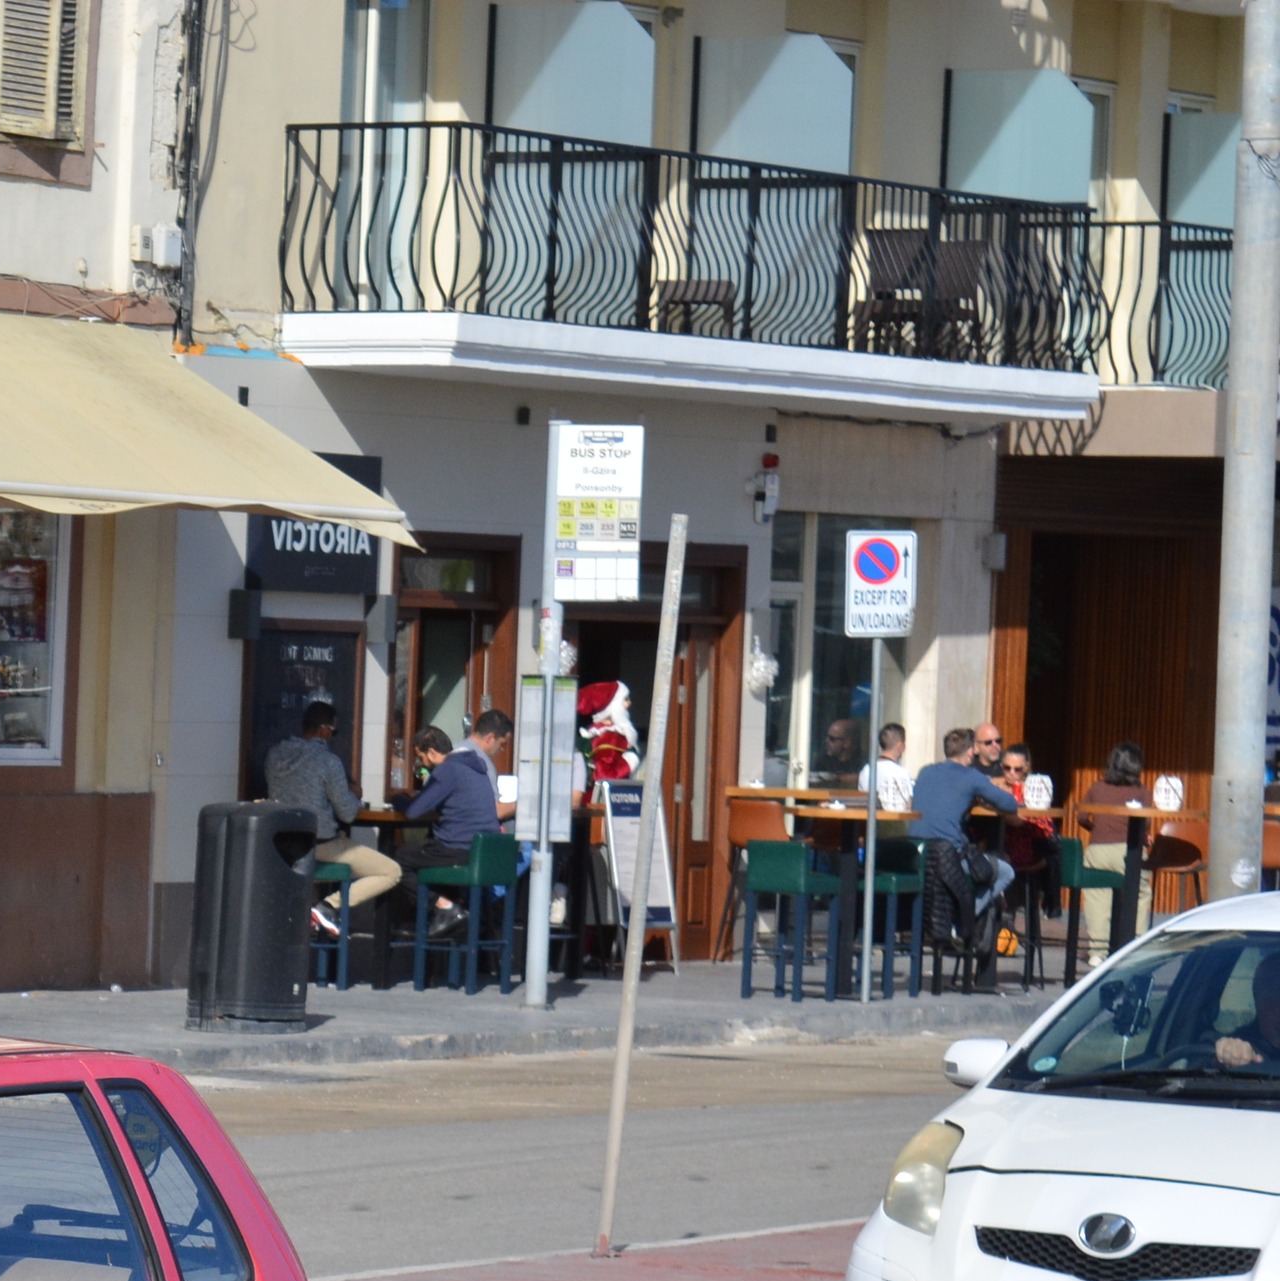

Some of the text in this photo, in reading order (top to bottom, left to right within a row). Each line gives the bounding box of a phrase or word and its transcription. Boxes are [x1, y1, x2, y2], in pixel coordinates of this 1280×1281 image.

[570, 448, 631, 459] BUS STOP
[574, 483, 623, 493] Ponsonby
[854, 589, 908, 605] EXCEPT FOR
